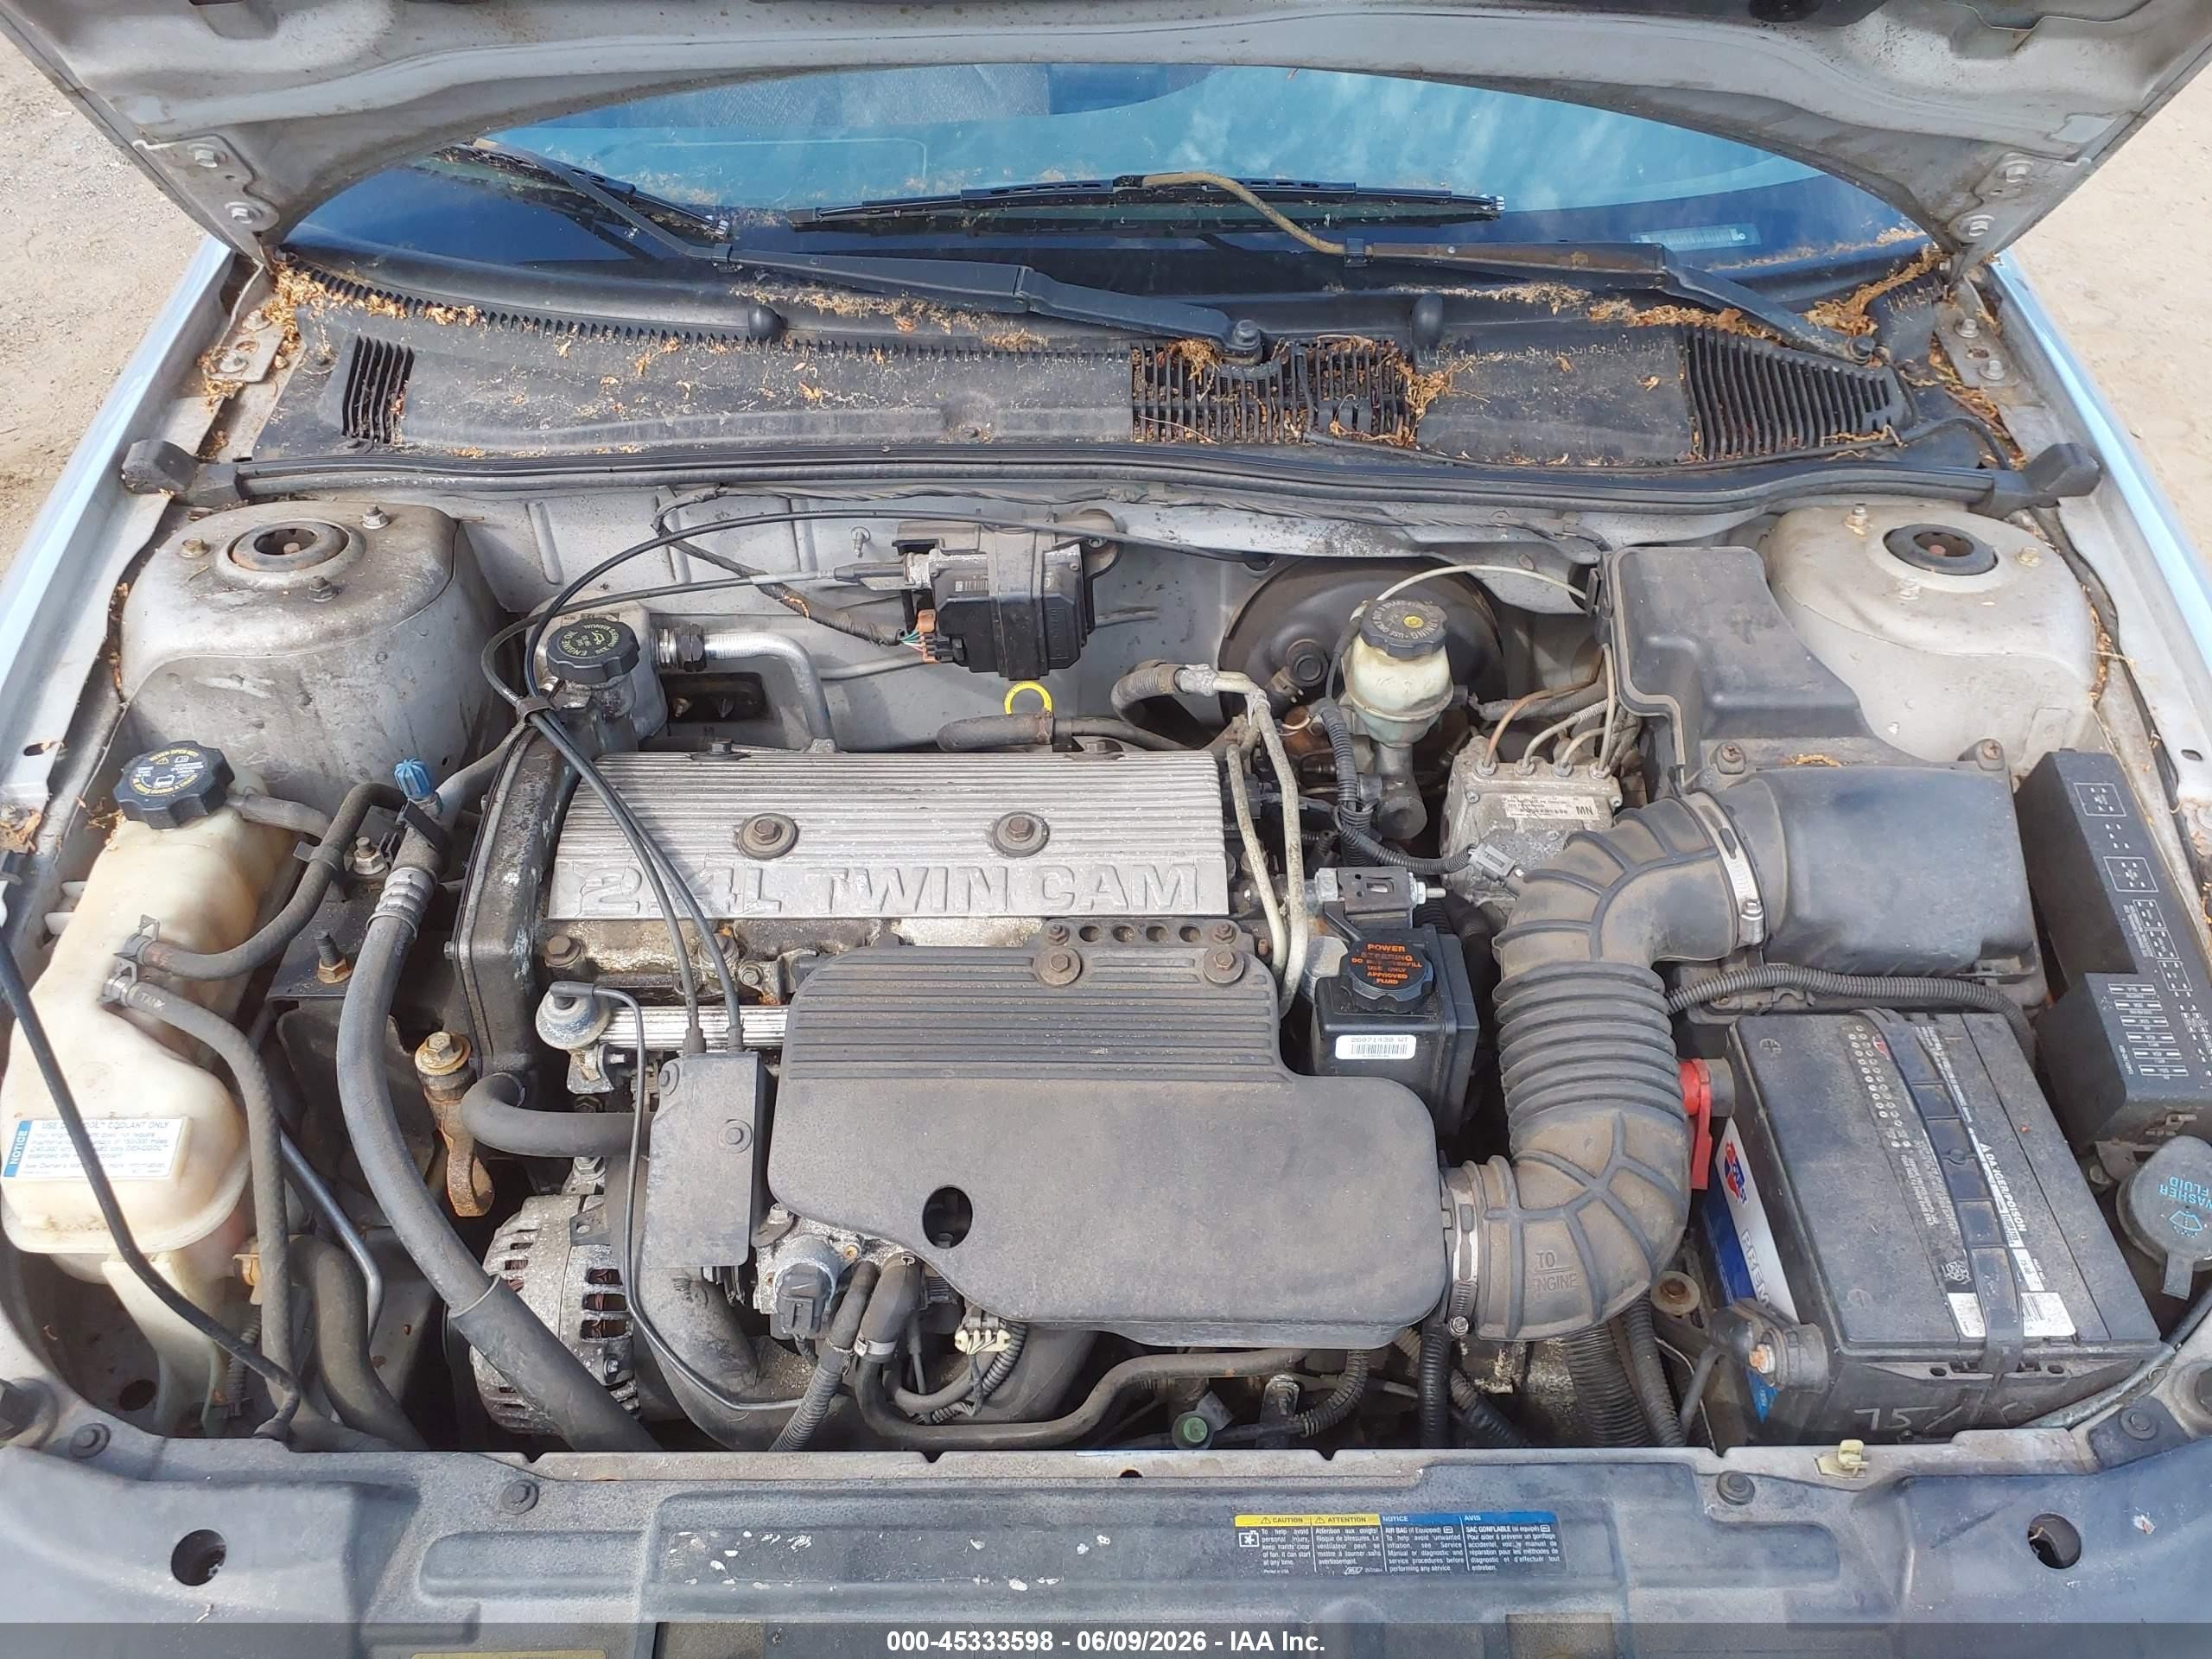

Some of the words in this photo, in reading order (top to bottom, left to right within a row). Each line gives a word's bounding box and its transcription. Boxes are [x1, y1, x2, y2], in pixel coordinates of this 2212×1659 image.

[561, 640, 588, 657] ENGINE
[1576, 805, 1593, 815] MN
[806, 867, 1009, 912] TWIN
[1038, 867, 1199, 912] CAM
[1367, 944, 1406, 952] POWER
[10, 1130, 28, 1165] NOTICE
[2170, 1176, 2209, 1197] FLUID
[1535, 1250, 1556, 1268] TO
